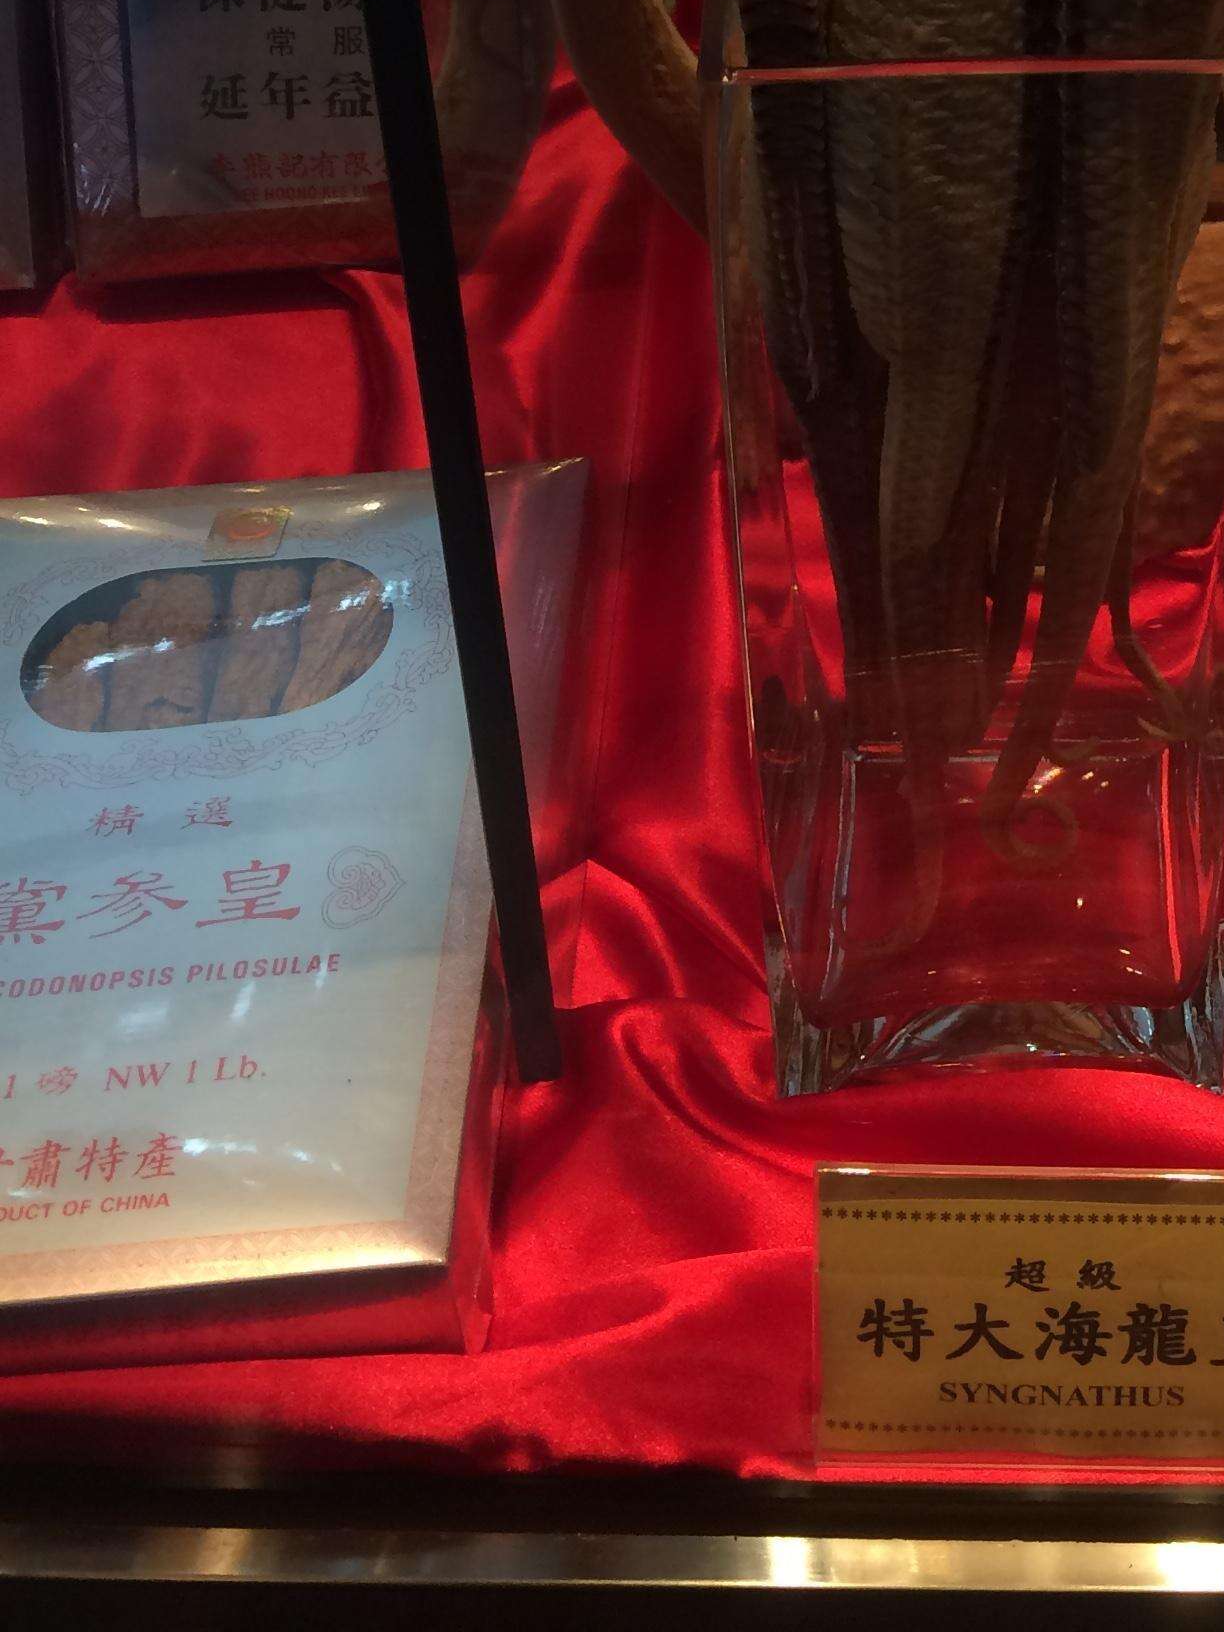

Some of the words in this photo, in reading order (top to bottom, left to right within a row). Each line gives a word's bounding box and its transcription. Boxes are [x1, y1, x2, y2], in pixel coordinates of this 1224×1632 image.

[264, 24, 366, 58] 常服
[200, 70, 375, 121] 延年益
[85, 796, 235, 839] 精選
[186, 952, 343, 984] PILOSULAE
[103, 1061, 173, 1092] NW
[61, 1198, 92, 1217] OF
[99, 1191, 172, 1214] CHINA
[1003, 1256, 1123, 1293] 超級
[937, 1380, 1185, 1409] SYNGNATHUS
